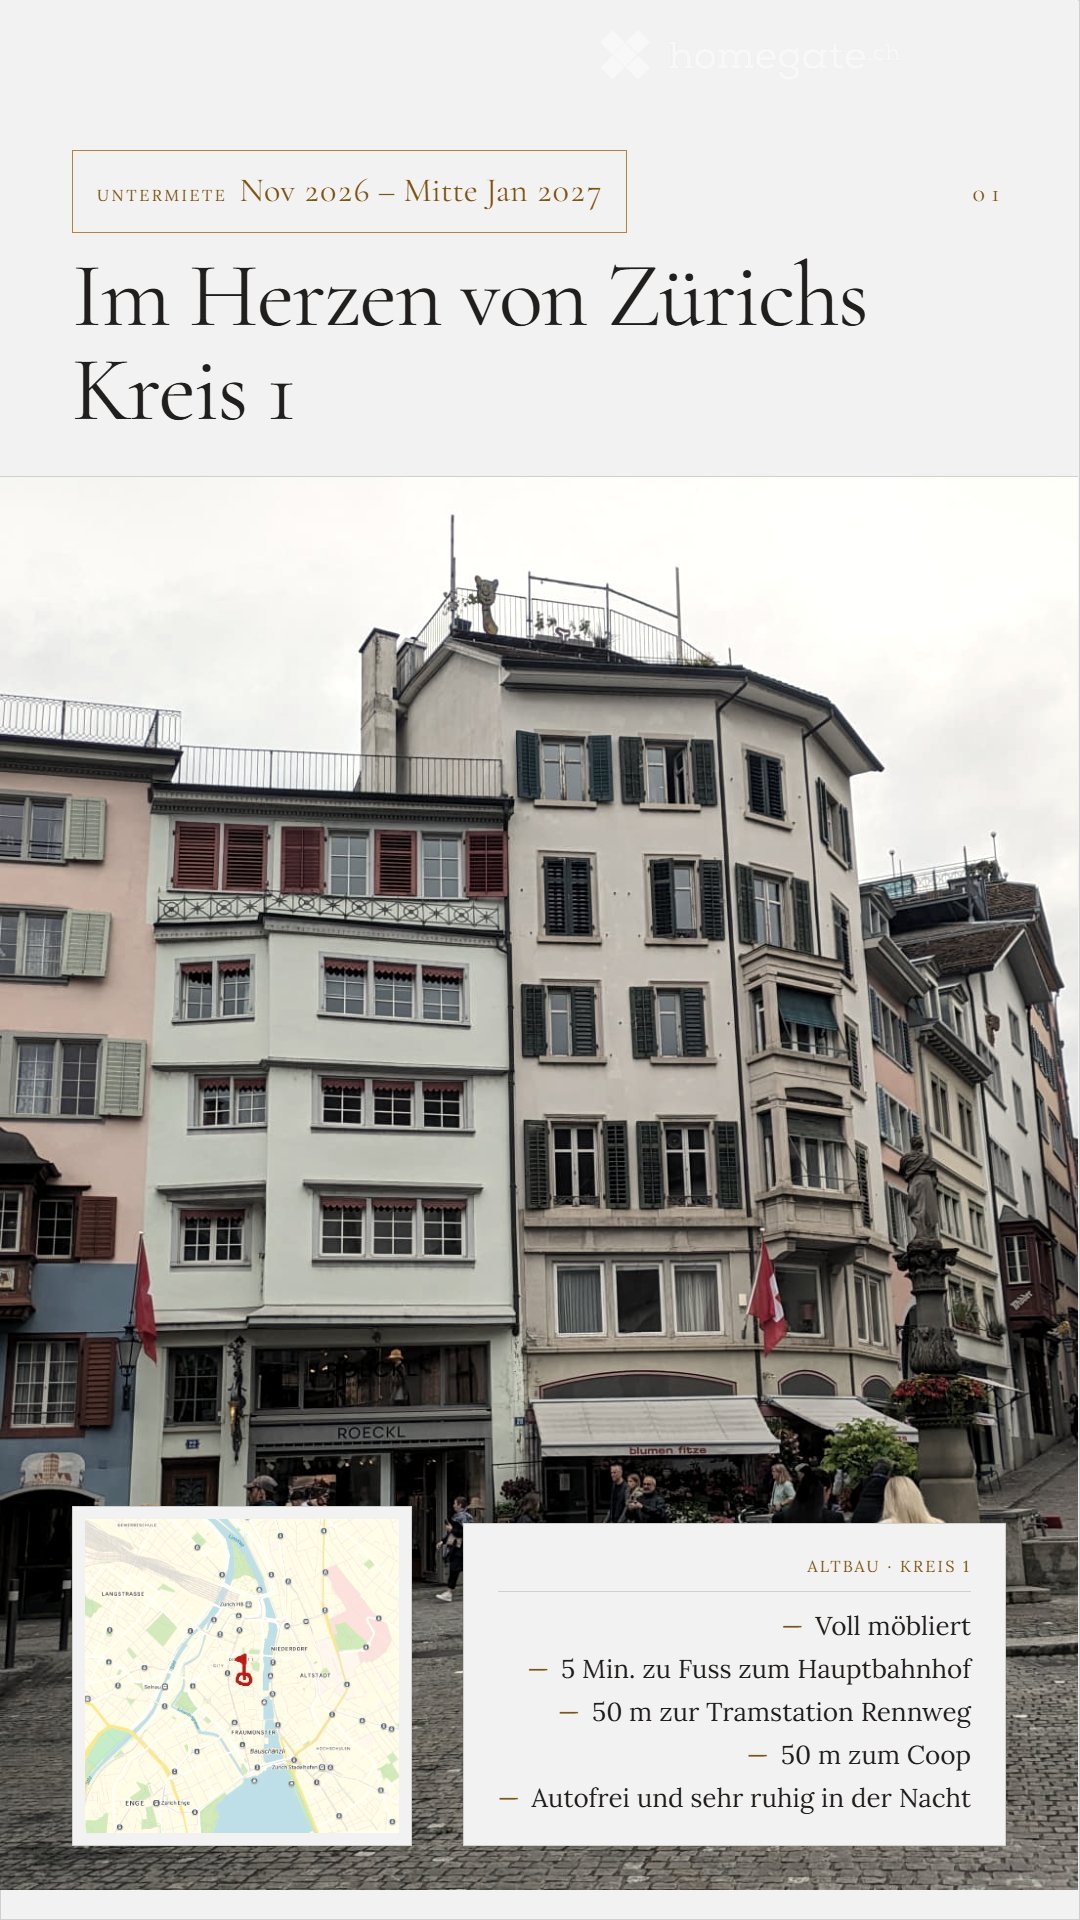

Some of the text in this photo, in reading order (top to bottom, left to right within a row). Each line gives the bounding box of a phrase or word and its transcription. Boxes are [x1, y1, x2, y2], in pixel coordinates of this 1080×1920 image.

[337, 1426, 406, 1440] ROECKL
[629, 1445, 707, 1455] blumen fitze
